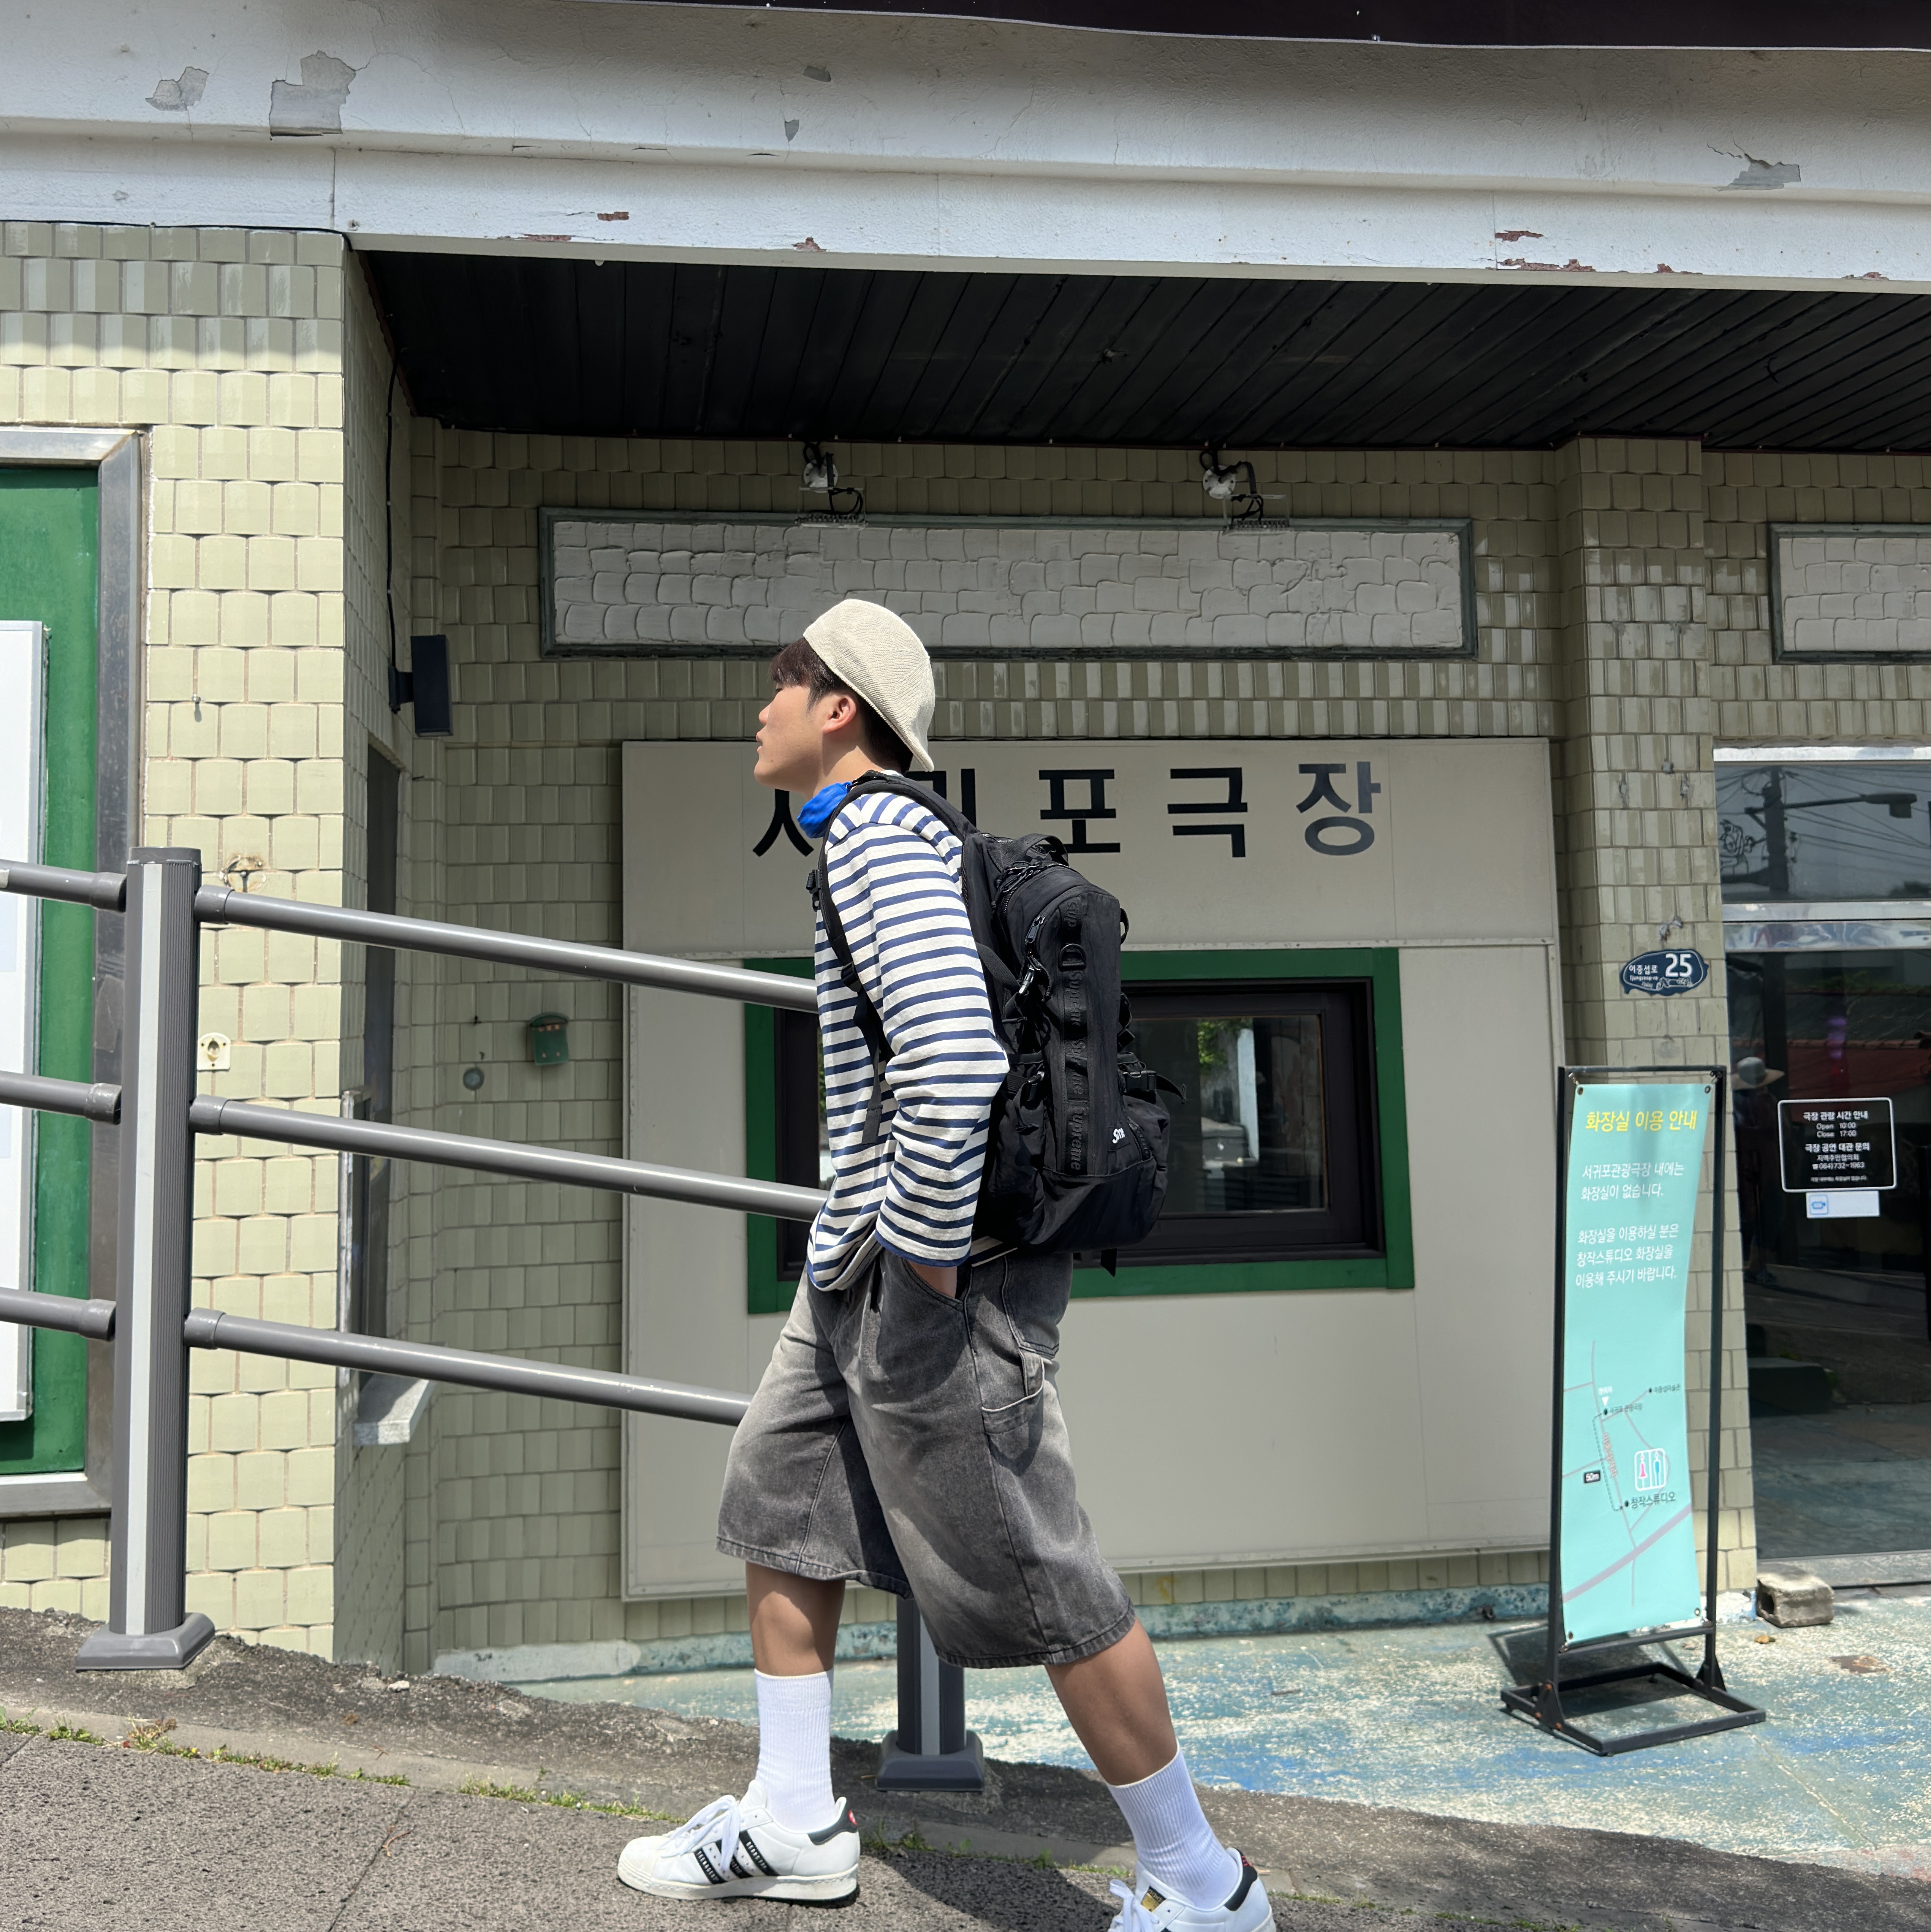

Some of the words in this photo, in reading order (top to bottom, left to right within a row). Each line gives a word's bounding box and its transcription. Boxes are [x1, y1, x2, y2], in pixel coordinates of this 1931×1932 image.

[1629, 964, 1658, 975] 이중섭로
[1665, 953, 1692, 977] 25
[1586, 1112, 1630, 1132] 화장실
[1635, 1111, 1664, 1131] 이용
[1669, 1111, 1697, 1130] 안내
[1803, 1112, 1818, 1121] 극장
[1820, 1112, 1835, 1121] 관람
[1837, 1111, 1851, 1120] 시간
[1853, 1111, 1868, 1120] 안내
[1068, 1106, 1089, 1170] Supreme
[1805, 1144, 1820, 1153] 극장
[1822, 1143, 1836, 1152] 공연
[1839, 1143, 1853, 1151] 대관
[1855, 1142, 1869, 1151] 문의
[1582, 1163, 1651, 1179] 서귀포관광극장
[1654, 1162, 1684, 1176] 내에는
[1581, 1185, 1619, 1201] 화장실이
[1622, 1183, 1663, 1198] 없습니다.
[1578, 1228, 1615, 1244] 화장실을
[1619, 1225, 1656, 1241] 이용하실
[1659, 1224, 1678, 1239] 분은
[1577, 1248, 1632, 1267] 창작스튜디오
[1635, 1244, 1673, 1261] 화장실을
[1576, 1272, 1603, 1288] 이용해
[1607, 1269, 1634, 1285] 주시기
[1637, 1266, 1676, 1282] 바랍니다.
[1631, 1491, 1676, 1509] 창작스튜디오
